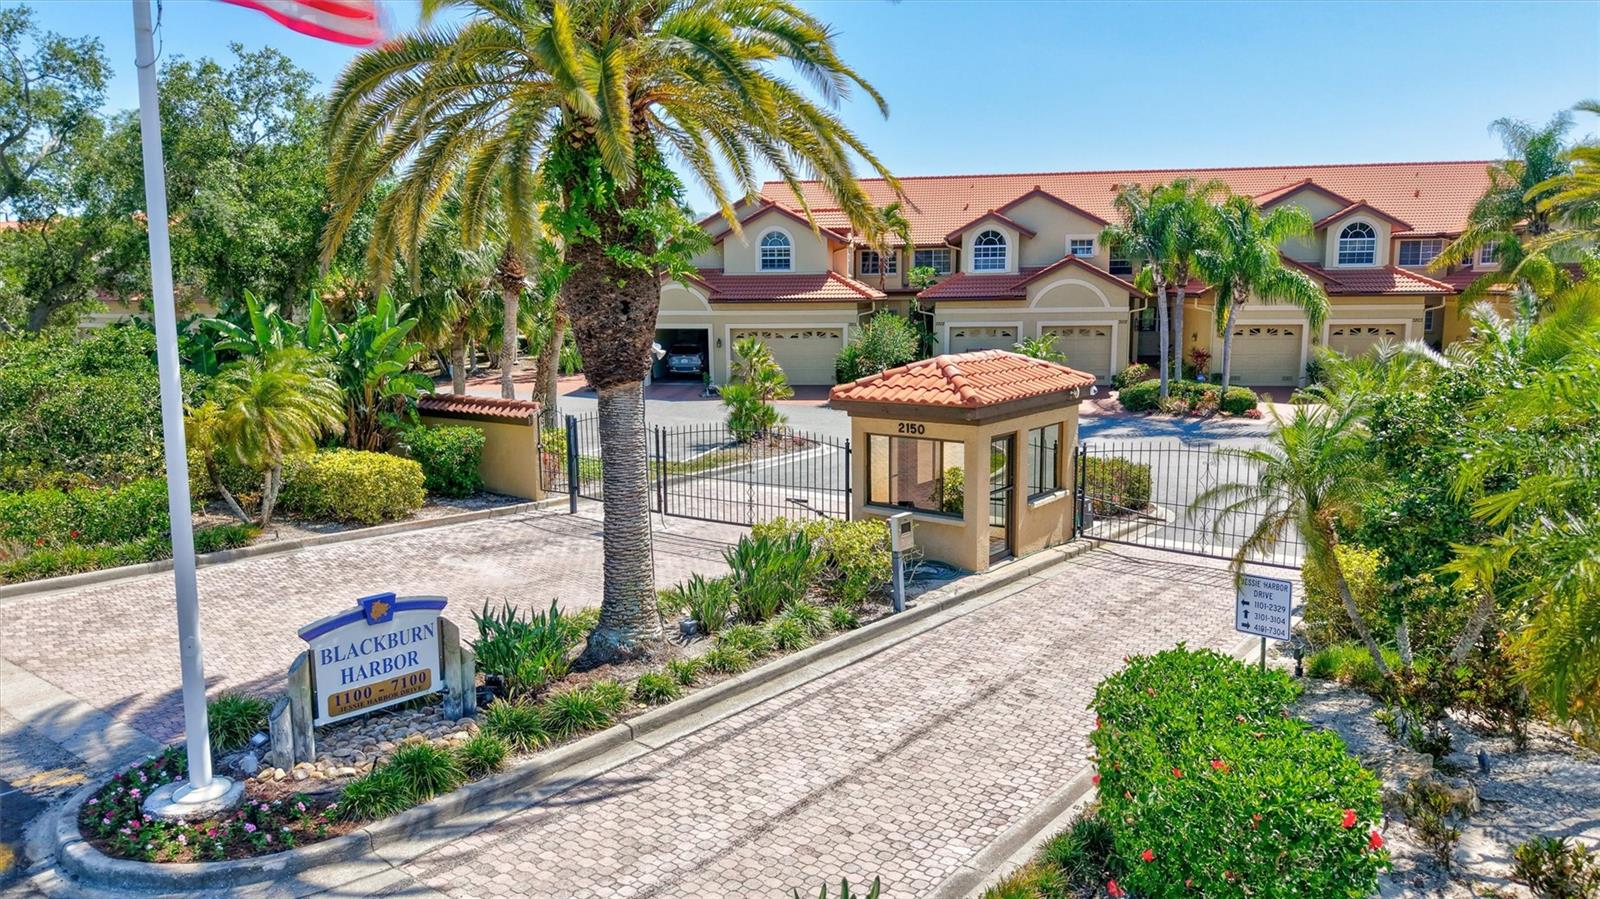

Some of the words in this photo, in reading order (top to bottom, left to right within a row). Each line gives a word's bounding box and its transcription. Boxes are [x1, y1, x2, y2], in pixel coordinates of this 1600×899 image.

[898, 422, 925, 435] 2150
[1263, 581, 1289, 592] HARBOR
[1253, 589, 1273, 600] DRIVE
[1254, 601, 1286, 613] 1101-2329
[1254, 612, 1286, 625] 3101-3104
[321, 622, 434, 666] BLACKBURN
[340, 650, 419, 685] HARBOR
[335, 687, 372, 707] 1100
[391, 671, 426, 692] 7100
